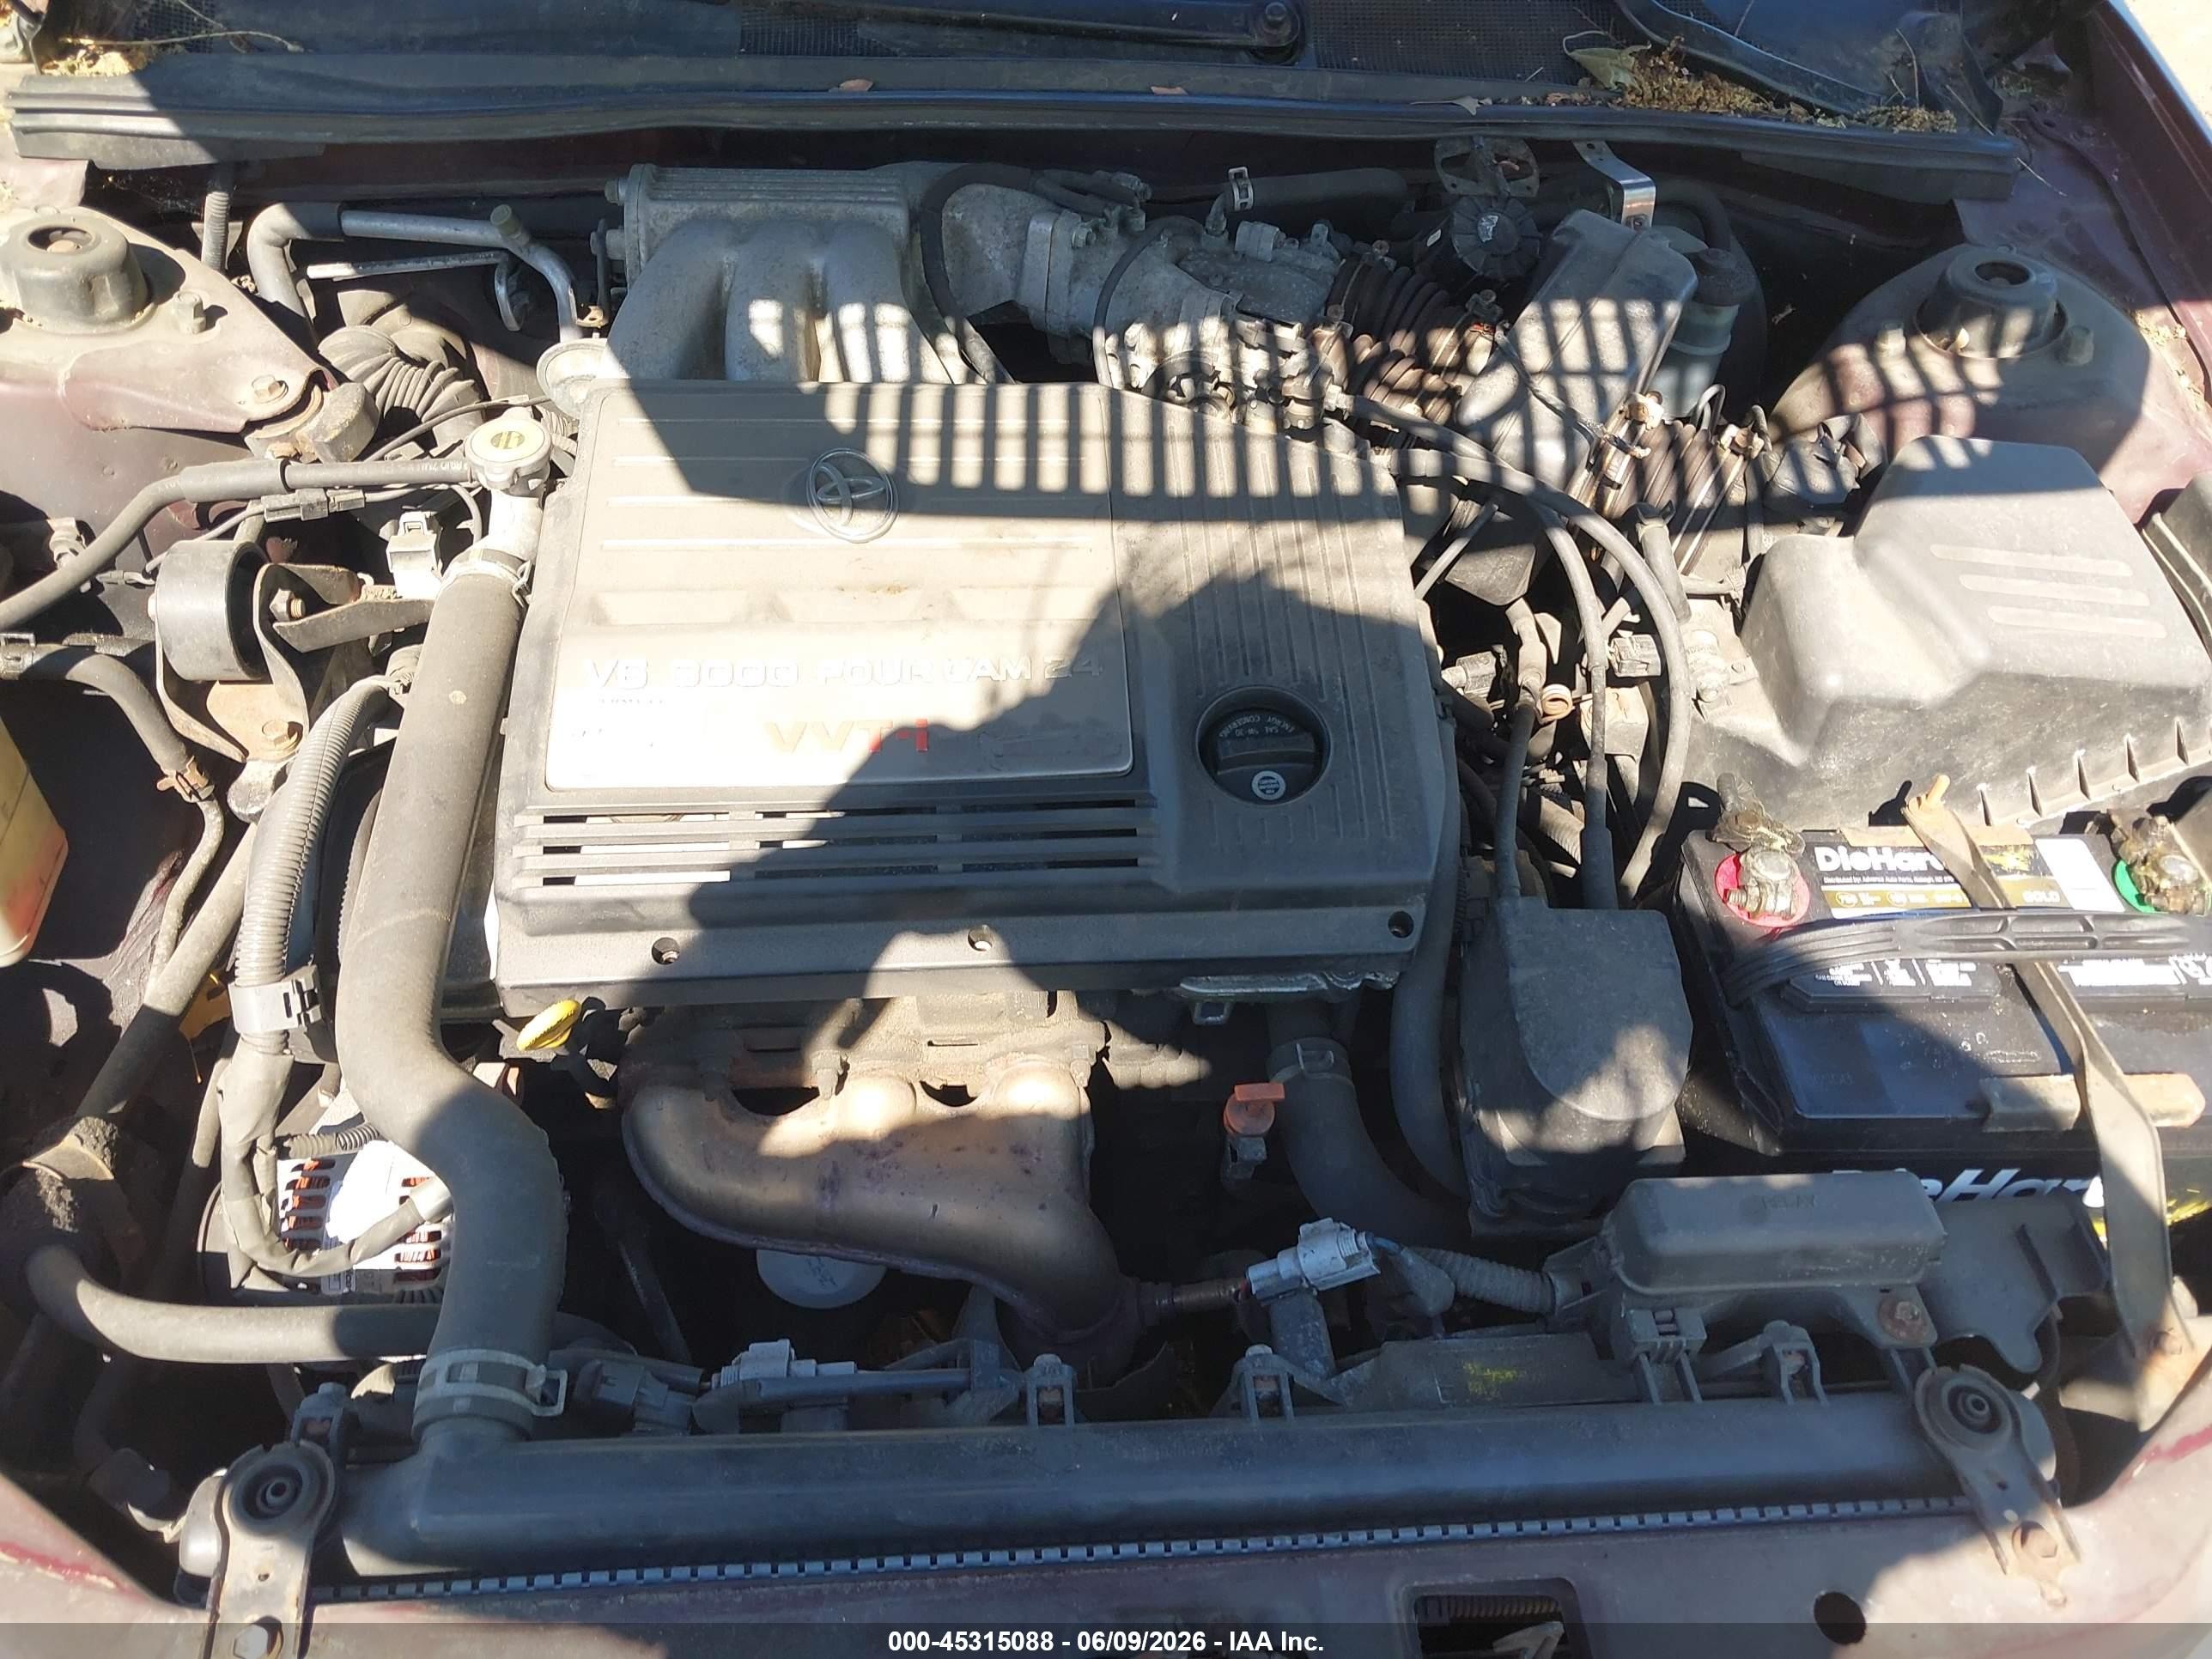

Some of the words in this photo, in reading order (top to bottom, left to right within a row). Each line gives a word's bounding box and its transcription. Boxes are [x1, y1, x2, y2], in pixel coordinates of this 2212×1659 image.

[586, 658, 649, 690] V6
[672, 658, 800, 688] 3000
[815, 657, 936, 687] FOUR
[945, 654, 1033, 684] CAM
[1043, 653, 1103, 680] 24
[2022, 890, 2060, 902] GOLD
